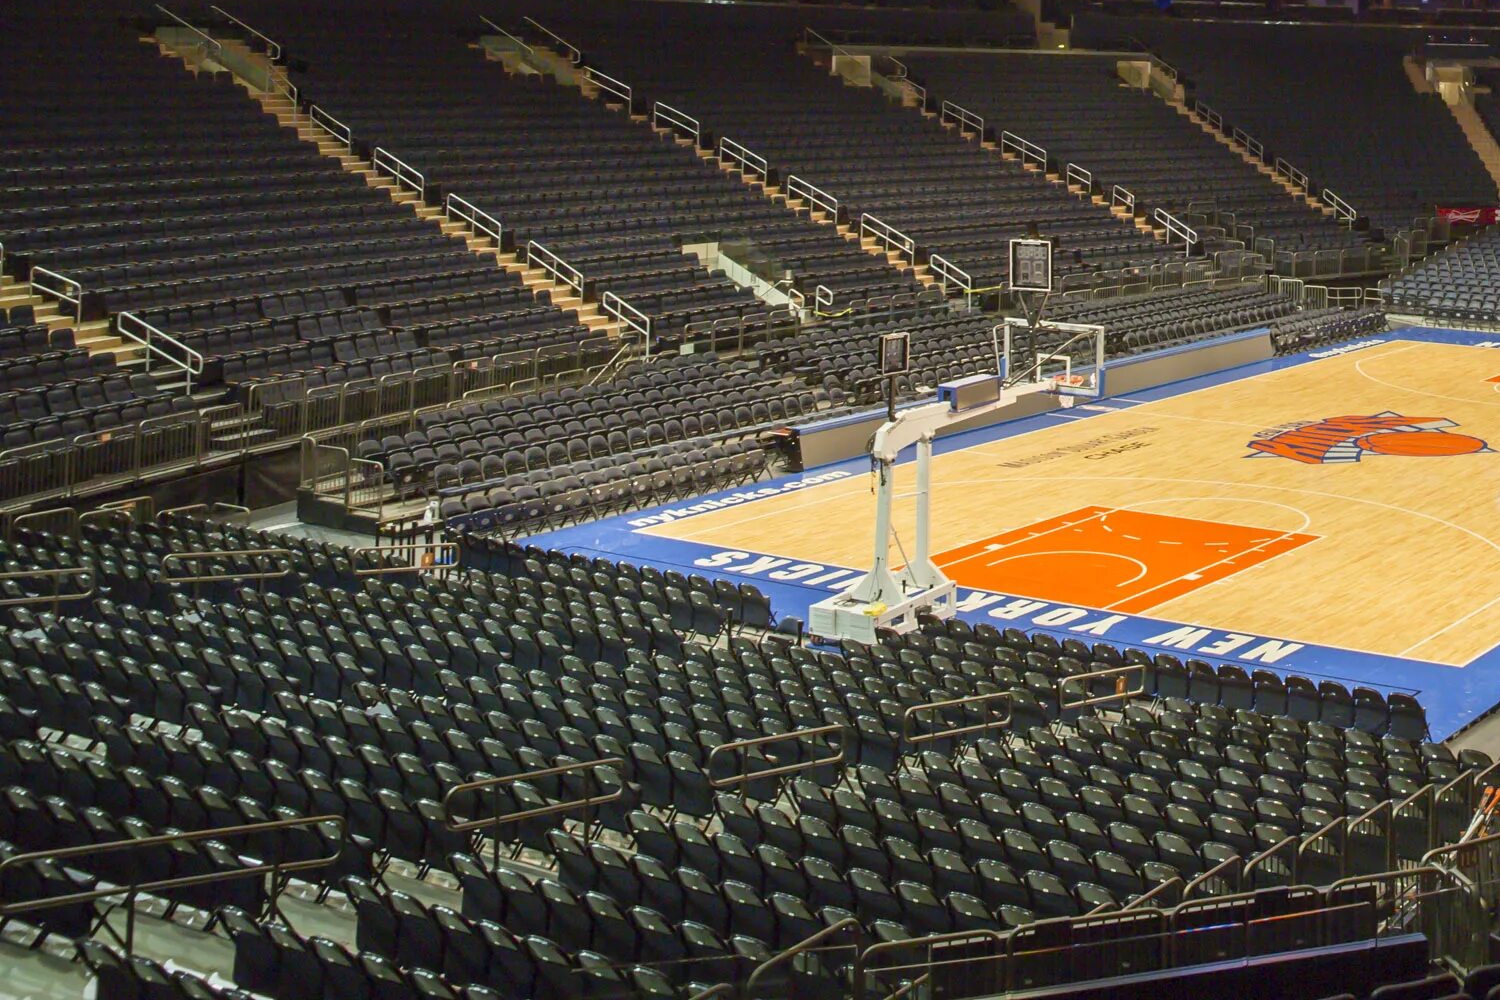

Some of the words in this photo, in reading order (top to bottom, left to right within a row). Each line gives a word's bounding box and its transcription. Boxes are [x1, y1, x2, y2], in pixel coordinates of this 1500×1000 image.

[1084, 441, 1152, 460] CHASE
[627, 471, 852, 527] nyknicks.com
[956, 591, 1128, 635] YORK
[1142, 626, 1304, 663] NEW
